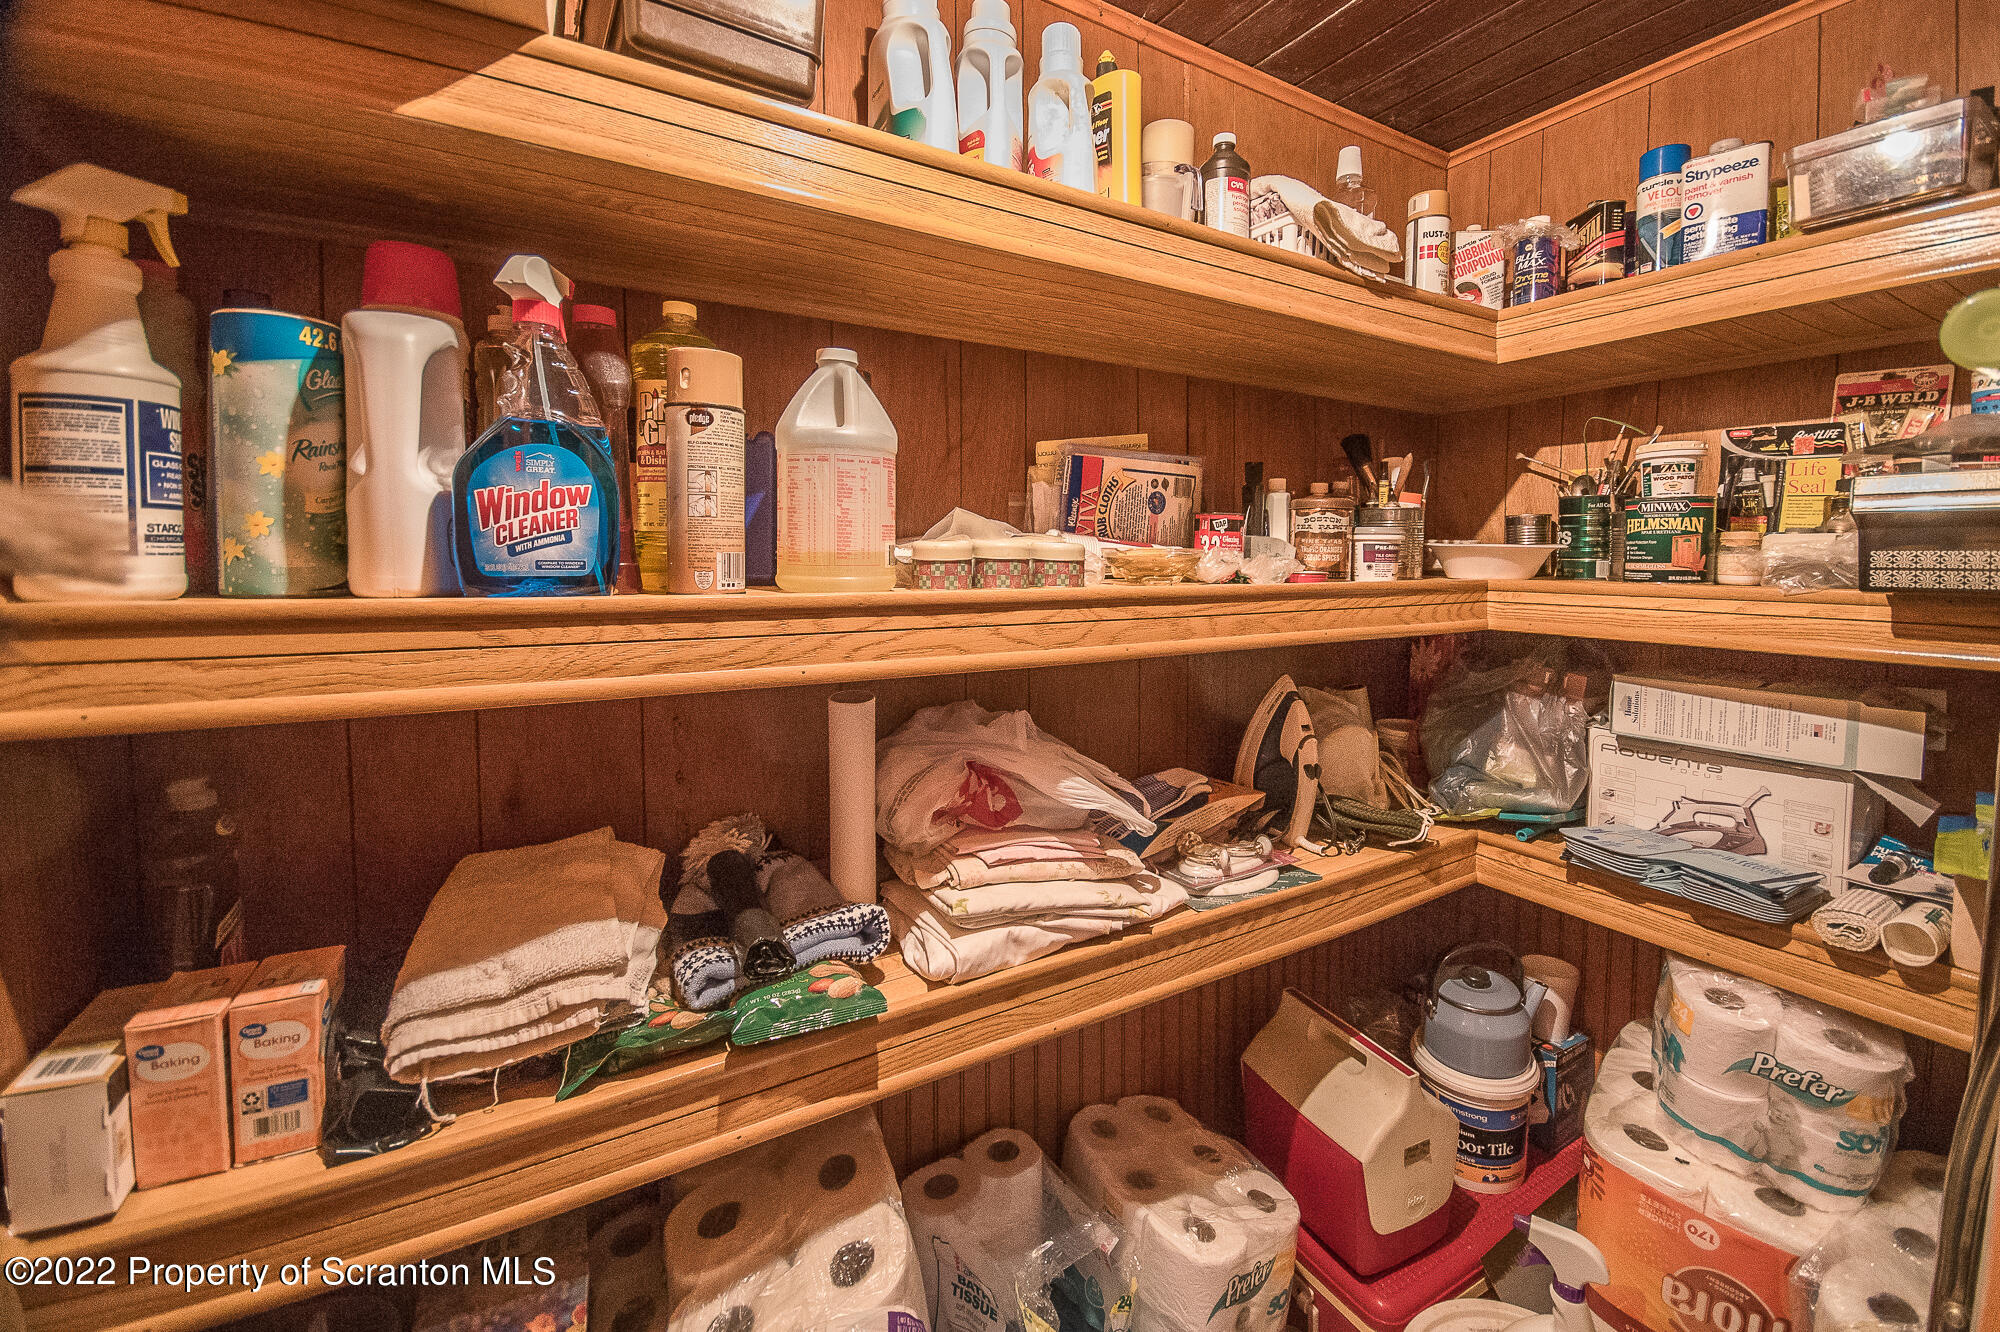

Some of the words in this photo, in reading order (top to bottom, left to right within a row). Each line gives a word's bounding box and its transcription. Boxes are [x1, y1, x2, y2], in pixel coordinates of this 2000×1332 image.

[1685, 157, 1759, 183] Strypeeze
[1230, 181, 1244, 190] CVS
[1684, 183, 1708, 196] paint
[1719, 172, 1754, 186] varnish
[1684, 187, 1723, 202] remover
[1454, 248, 1504, 279] COMPOUND
[1515, 250, 1544, 265] BLUE
[299, 326, 337, 351] 42.6
[640, 391, 667, 421] PIN
[1846, 395, 1876, 408] J-B
[1880, 391, 1940, 404] WELD
[689, 413, 710, 425] pledge
[643, 417, 667, 446] GL
[525, 459, 555, 467] SIMPLY
[1660, 463, 1689, 473] ZAR
[1789, 461, 1828, 477] Life
[1098, 476, 1119, 515] CLOTHS
[1787, 479, 1826, 494] Seal
[474, 479, 592, 531] Window
[1075, 486, 1099, 536] VIVA
[1641, 502, 1686, 512] MINWAX
[495, 508, 579, 547] CLEANER
[1097, 516, 1110, 539] RUB
[1215, 520, 1227, 528] DAP
[1626, 516, 1704, 535] HELMSMAN
[514, 540, 532, 553] WITH
[533, 534, 566, 548] AMMONIA
[1624, 695, 1633, 717] Home
[1632, 690, 1640, 724] Solutions
[1670, 766, 1723, 781] FOCUS
[253, 1033, 301, 1049] Baking
[150, 1055, 201, 1071] Baking
[1749, 1051, 1845, 1103] Prefer
[1446, 1103, 1488, 1124] rmstrong
[1456, 1153, 1476, 1163] esive
[1457, 1140, 1485, 1155] oor
[1487, 1143, 1514, 1156] Tile
[1687, 1223, 1716, 1246] 170
[957, 1274, 992, 1305] BATH
[1225, 1256, 1276, 1309] Prefer
[951, 1281, 998, 1323] TISSUE
[1118, 1295, 1133, 1309] 24
